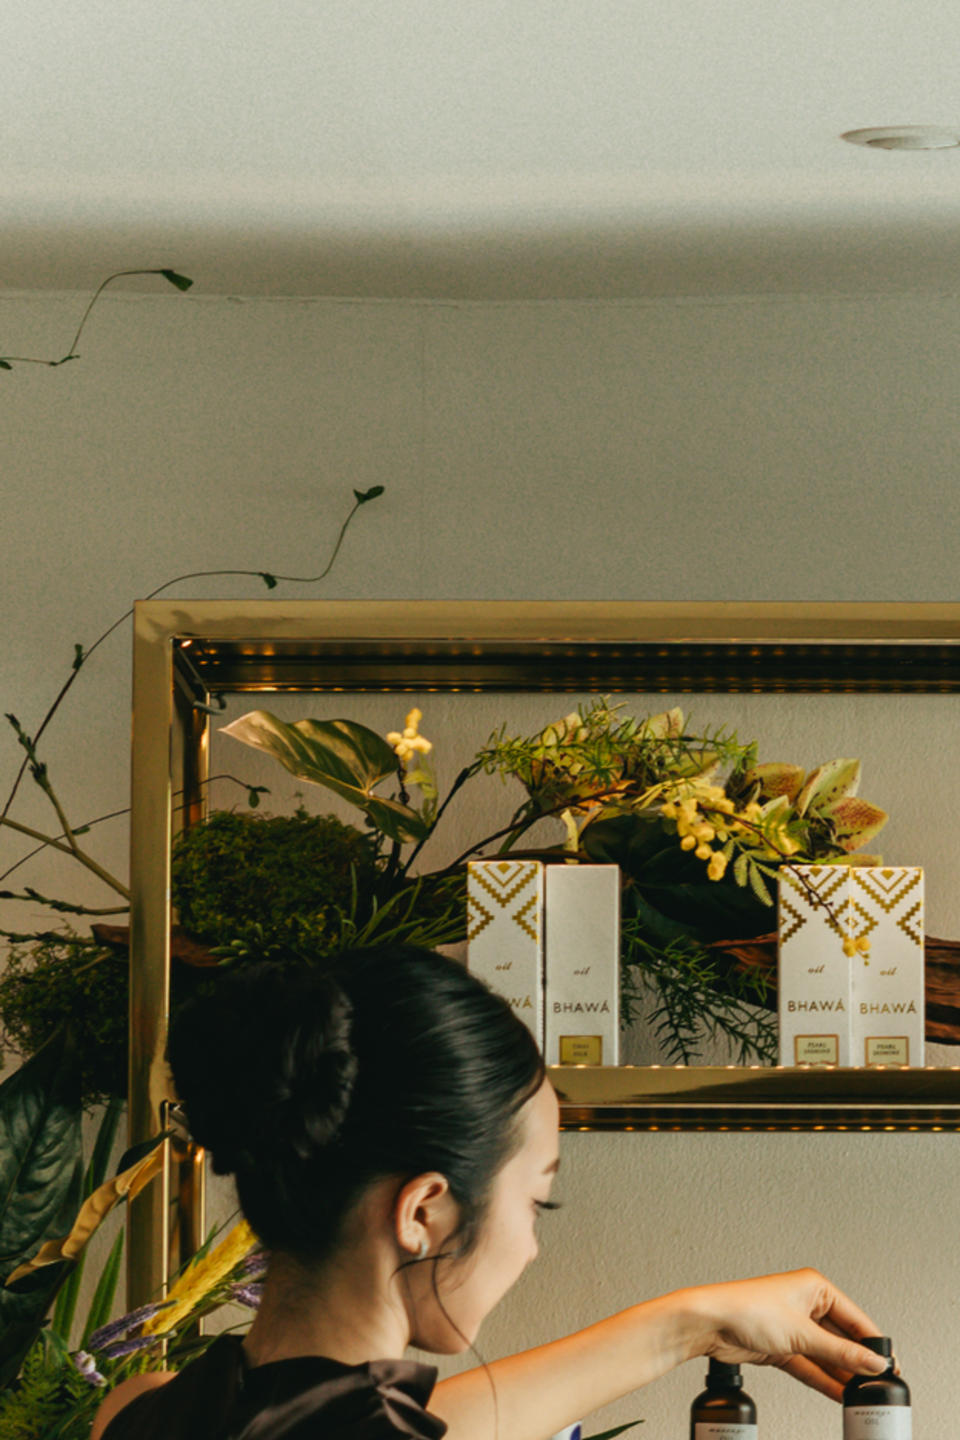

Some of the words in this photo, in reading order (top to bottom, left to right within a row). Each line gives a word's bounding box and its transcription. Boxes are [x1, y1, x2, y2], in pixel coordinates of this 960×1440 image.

[553, 1000, 610, 1013] BHAWÁ
[787, 998, 846, 1013] BHAWÁ
[859, 1000, 917, 1015] BHAWÁ
